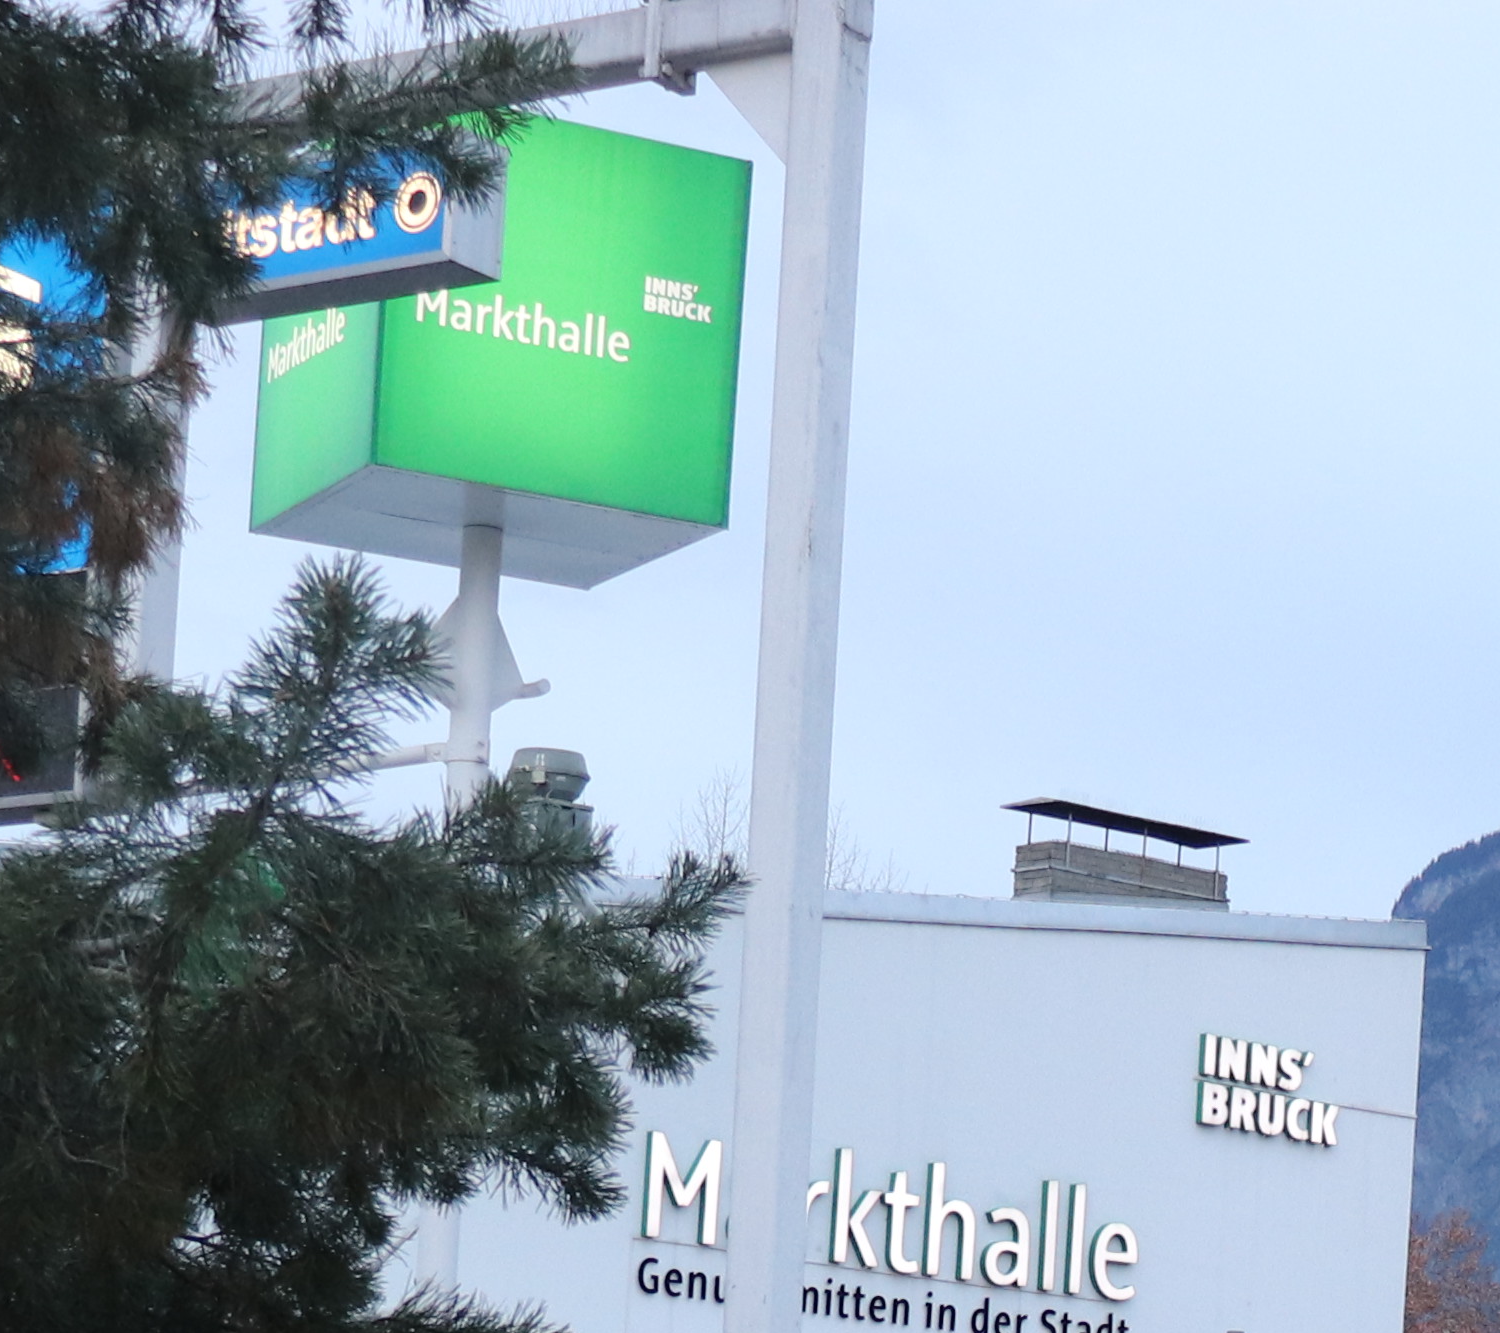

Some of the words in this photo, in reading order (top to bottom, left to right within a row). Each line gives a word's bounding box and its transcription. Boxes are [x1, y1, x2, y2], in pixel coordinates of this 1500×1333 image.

[222, 185, 377, 259] tstadt
[643, 294, 712, 324] BRUCK
[644, 275, 699, 301] INNS'
[266, 307, 346, 383] Markthalle
[415, 288, 631, 363] Markthalle
[1199, 1032, 1315, 1092] INNS'
[1196, 1081, 1340, 1147] BRUCK
[641, 1130, 1139, 1301] Mrkthalle
[638, 1258, 726, 1305] Genu
[925, 1291, 957, 1333] in
